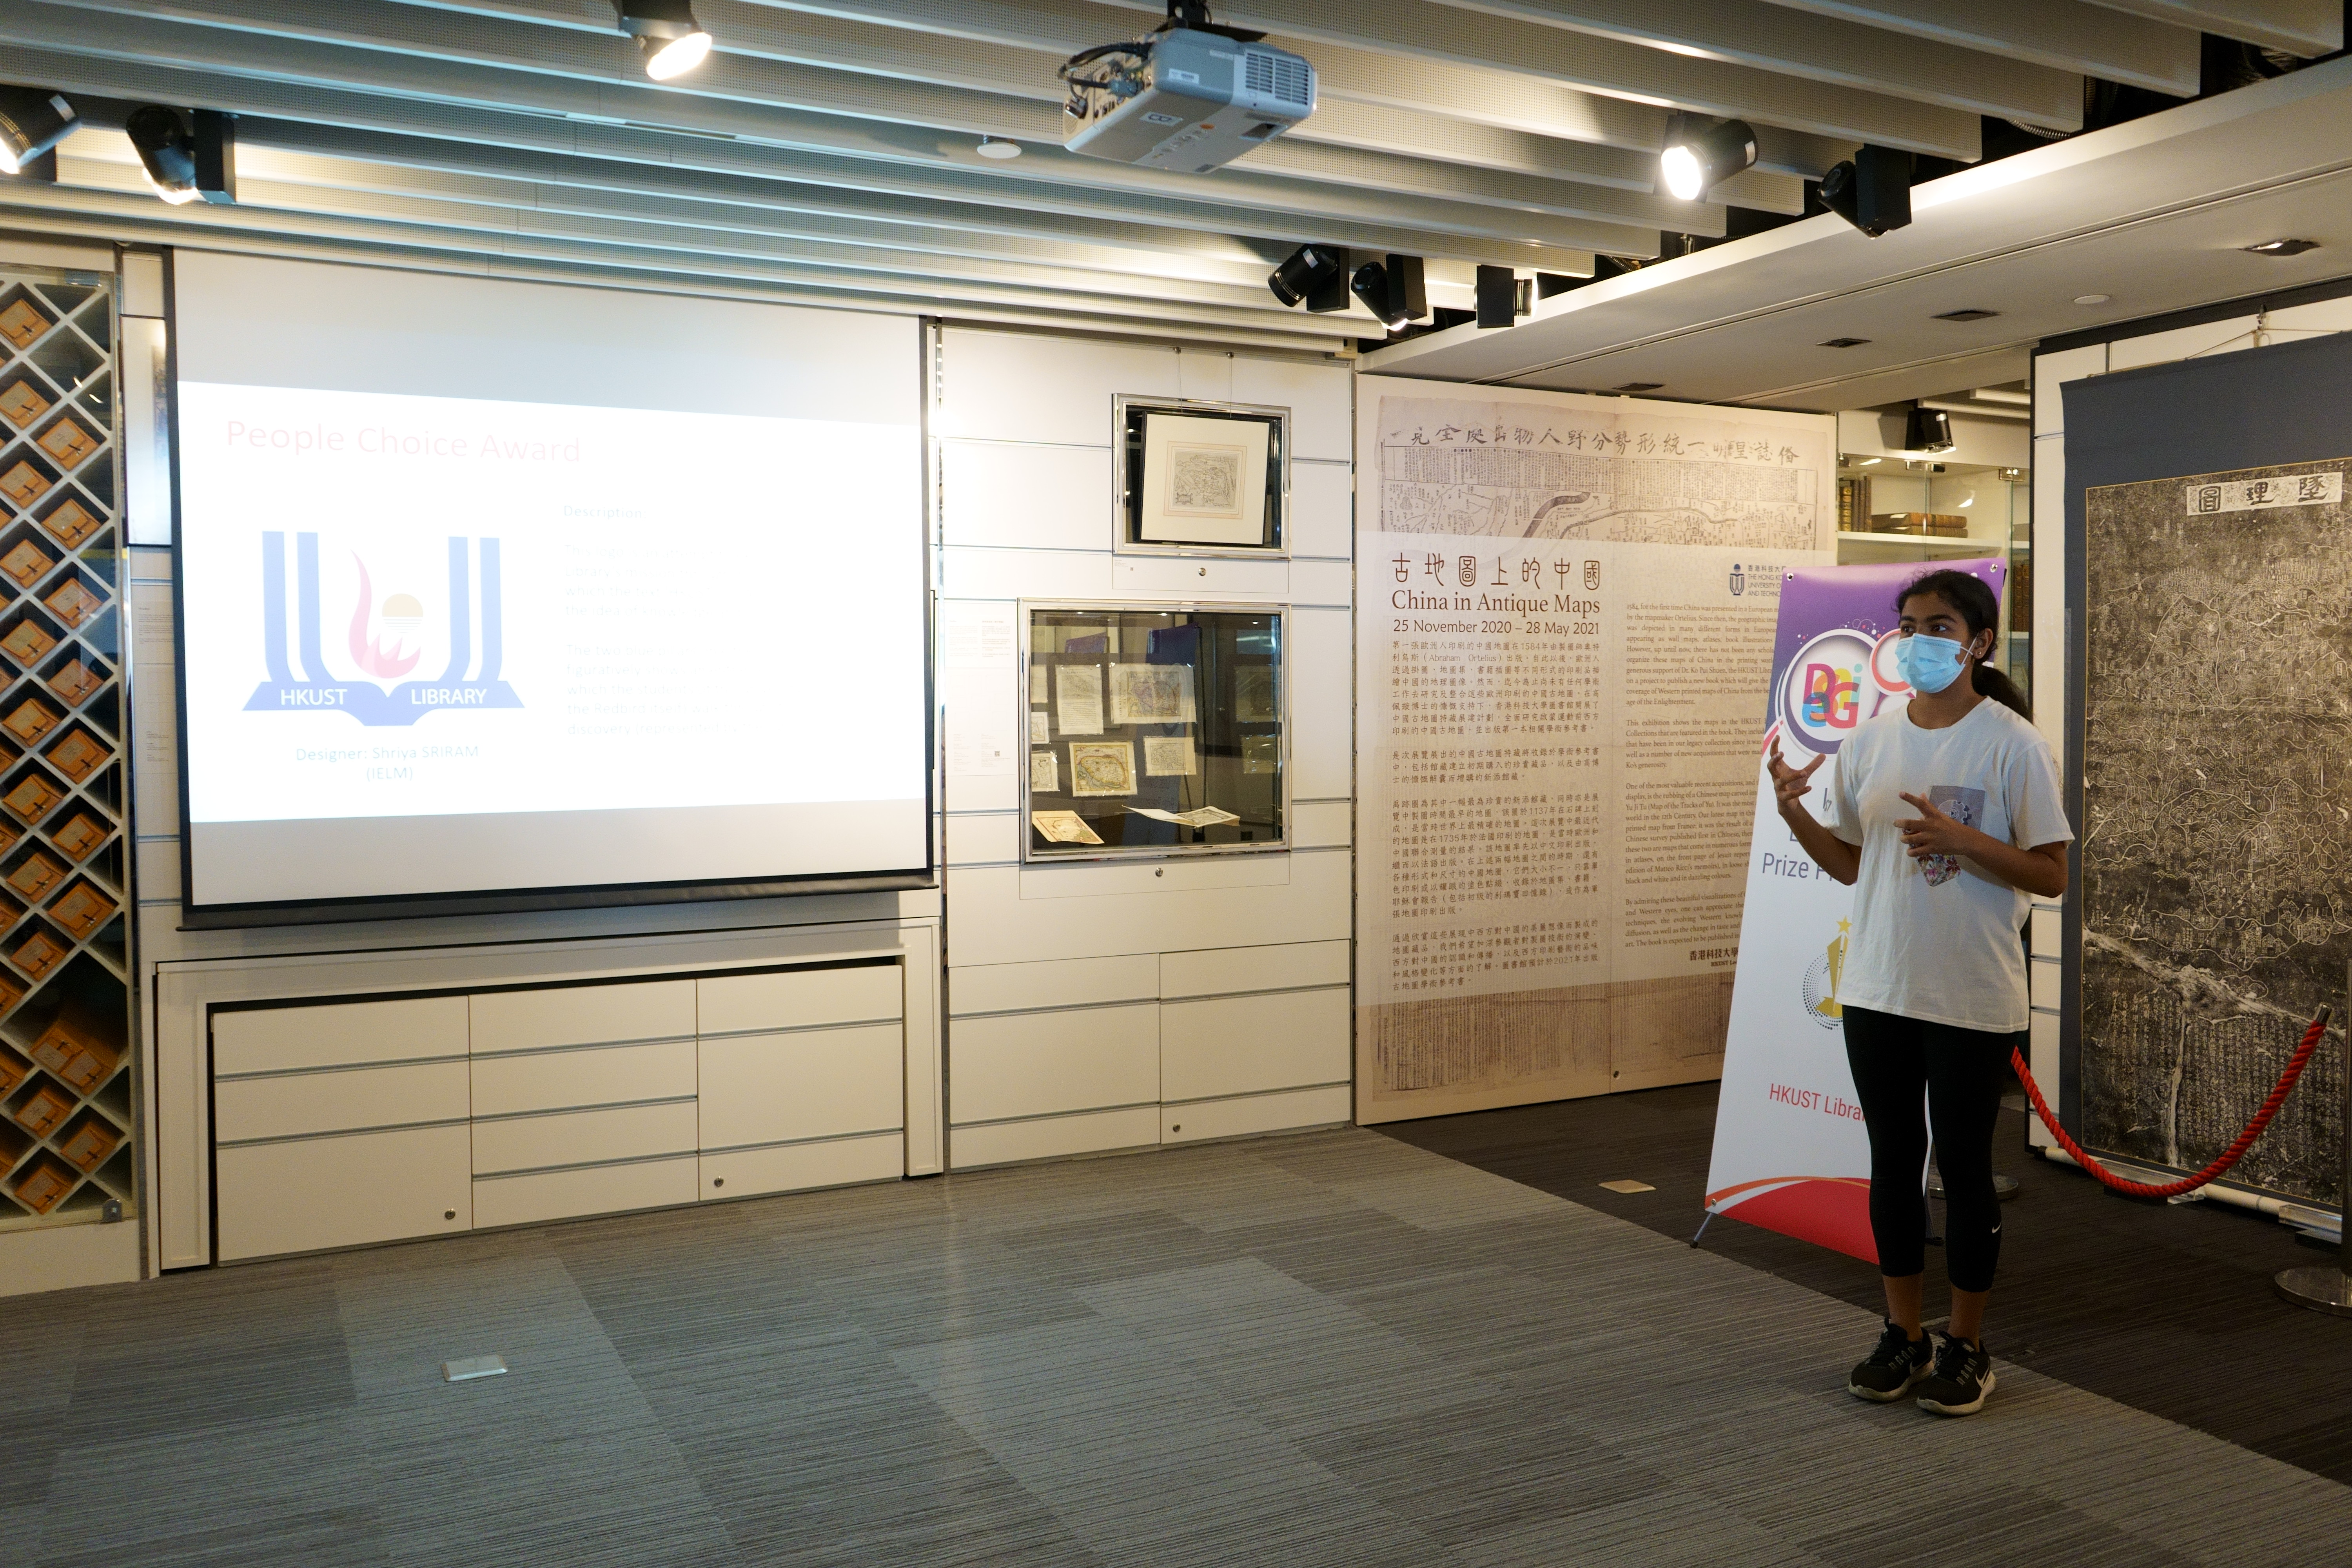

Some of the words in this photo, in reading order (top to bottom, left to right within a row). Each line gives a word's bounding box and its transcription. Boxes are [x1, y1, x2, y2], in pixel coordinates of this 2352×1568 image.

[227, 421, 345, 456] People
[358, 427, 468, 458] Choice
[480, 433, 581, 463] Award
[563, 504, 647, 520] Description:
[1392, 552, 1600, 590] 古地圖上的中國
[1392, 590, 1448, 610] China
[1454, 592, 1472, 611] in
[1477, 592, 1548, 617] Antique
[1554, 594, 1600, 618] Maps
[1394, 619, 1408, 632] 25
[1414, 620, 1477, 633] November
[1481, 621, 1512, 633] 2020
[1526, 621, 1540, 633] 28
[1545, 622, 1569, 637] May
[1573, 622, 1599, 634] 2021
[281, 689, 347, 706] HKUST
[411, 688, 487, 705] LIBRARY
[296, 746, 368, 762] Designer:
[372, 745, 417, 761] Shriya
[422, 745, 479, 759] SRIRAM
[367, 766, 413, 782] (IELM)
[1762, 853, 1809, 878] Prize
[1769, 1083, 1821, 1111] HKUST
[1824, 1096, 1865, 1121] Libra
